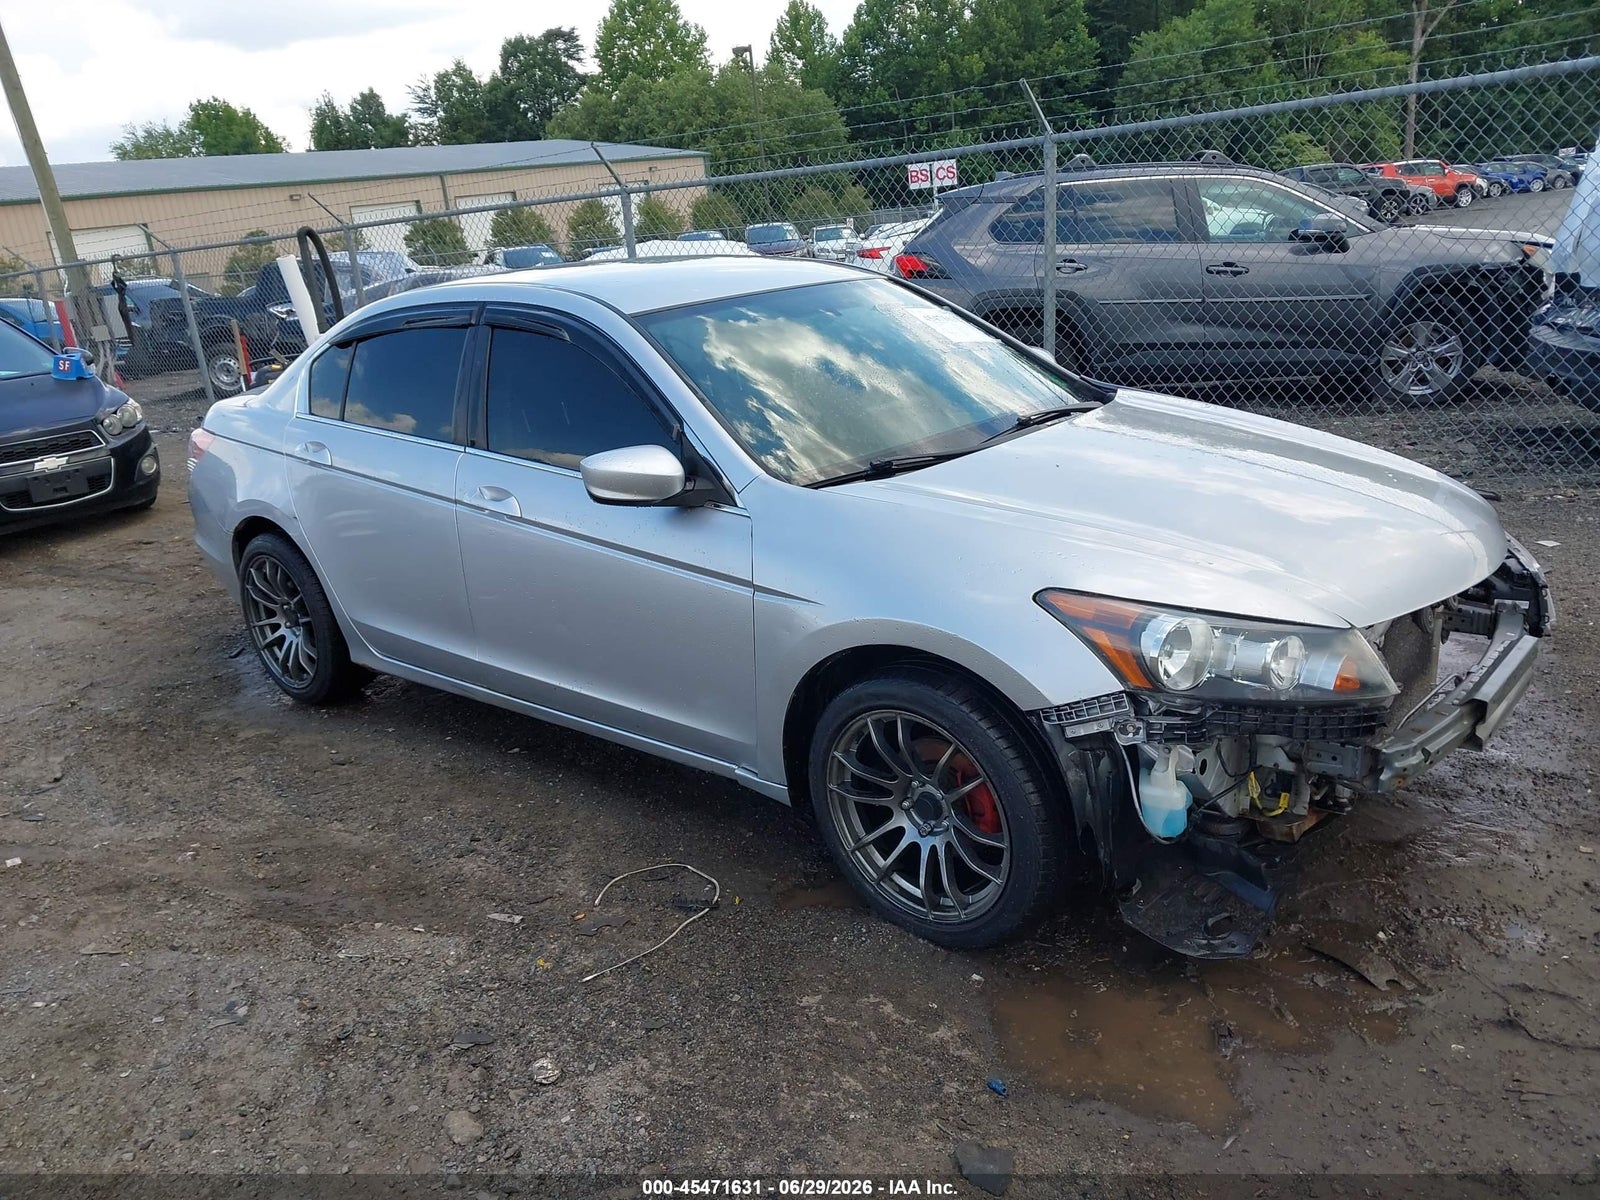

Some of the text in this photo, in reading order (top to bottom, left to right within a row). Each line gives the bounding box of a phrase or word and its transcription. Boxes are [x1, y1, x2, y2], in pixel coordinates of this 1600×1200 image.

[909, 169, 929, 183] BS
[935, 165, 956, 180] CS
[58, 360, 71, 371] SF
